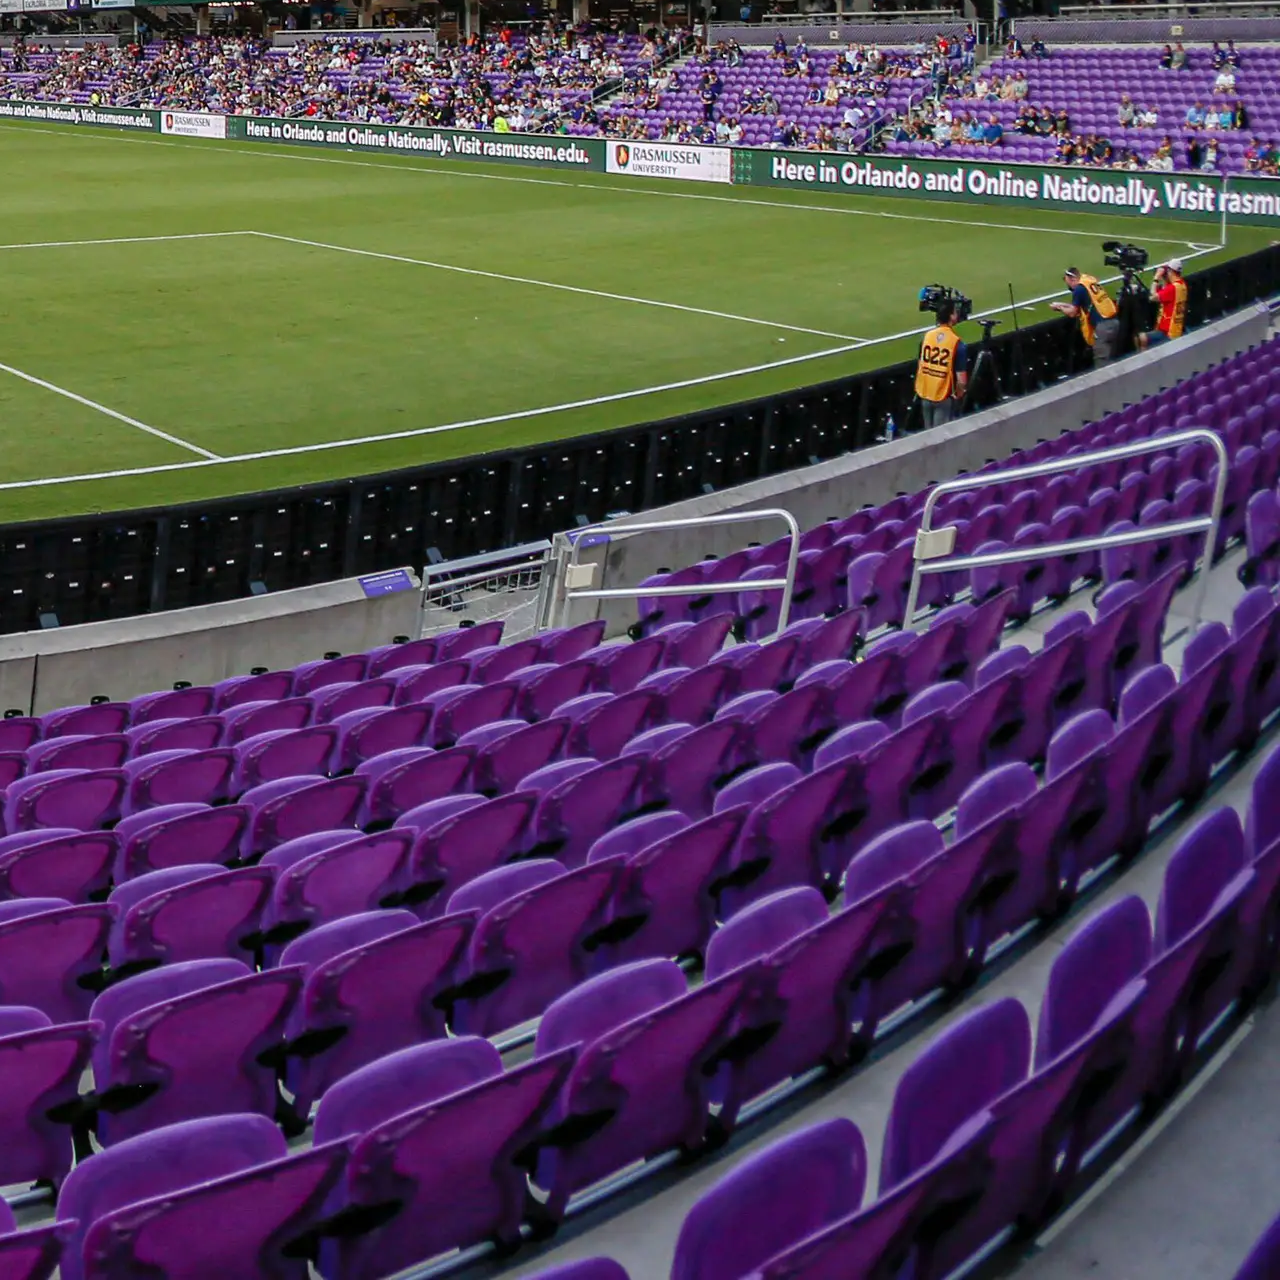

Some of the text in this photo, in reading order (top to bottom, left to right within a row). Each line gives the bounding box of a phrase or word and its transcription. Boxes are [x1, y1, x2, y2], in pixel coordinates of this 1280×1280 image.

[14, 104, 26, 117] and
[26, 105, 46, 118] Online
[47, 106, 81, 124] Nationally.
[81, 108, 97, 122] Visit
[97, 111, 153, 128] rasmussen.edu.
[175, 115, 211, 127] RASMUSSEN
[246, 121, 590, 164] Here in Orlando and Online Nationally. Visit rasmussen.edu.
[632, 147, 701, 165] RASMUSSEN
[632, 163, 677, 176] UNIVERSITY
[772, 156, 816, 182] Here
[819, 160, 837, 183] in
[841, 161, 920, 190] Orlando
[924, 168, 964, 193] and
[967, 170, 1039, 199] Online
[1042, 174, 1161, 214] Nationally.
[1163, 181, 1215, 212] Visit
[924, 345, 950, 367] 022
